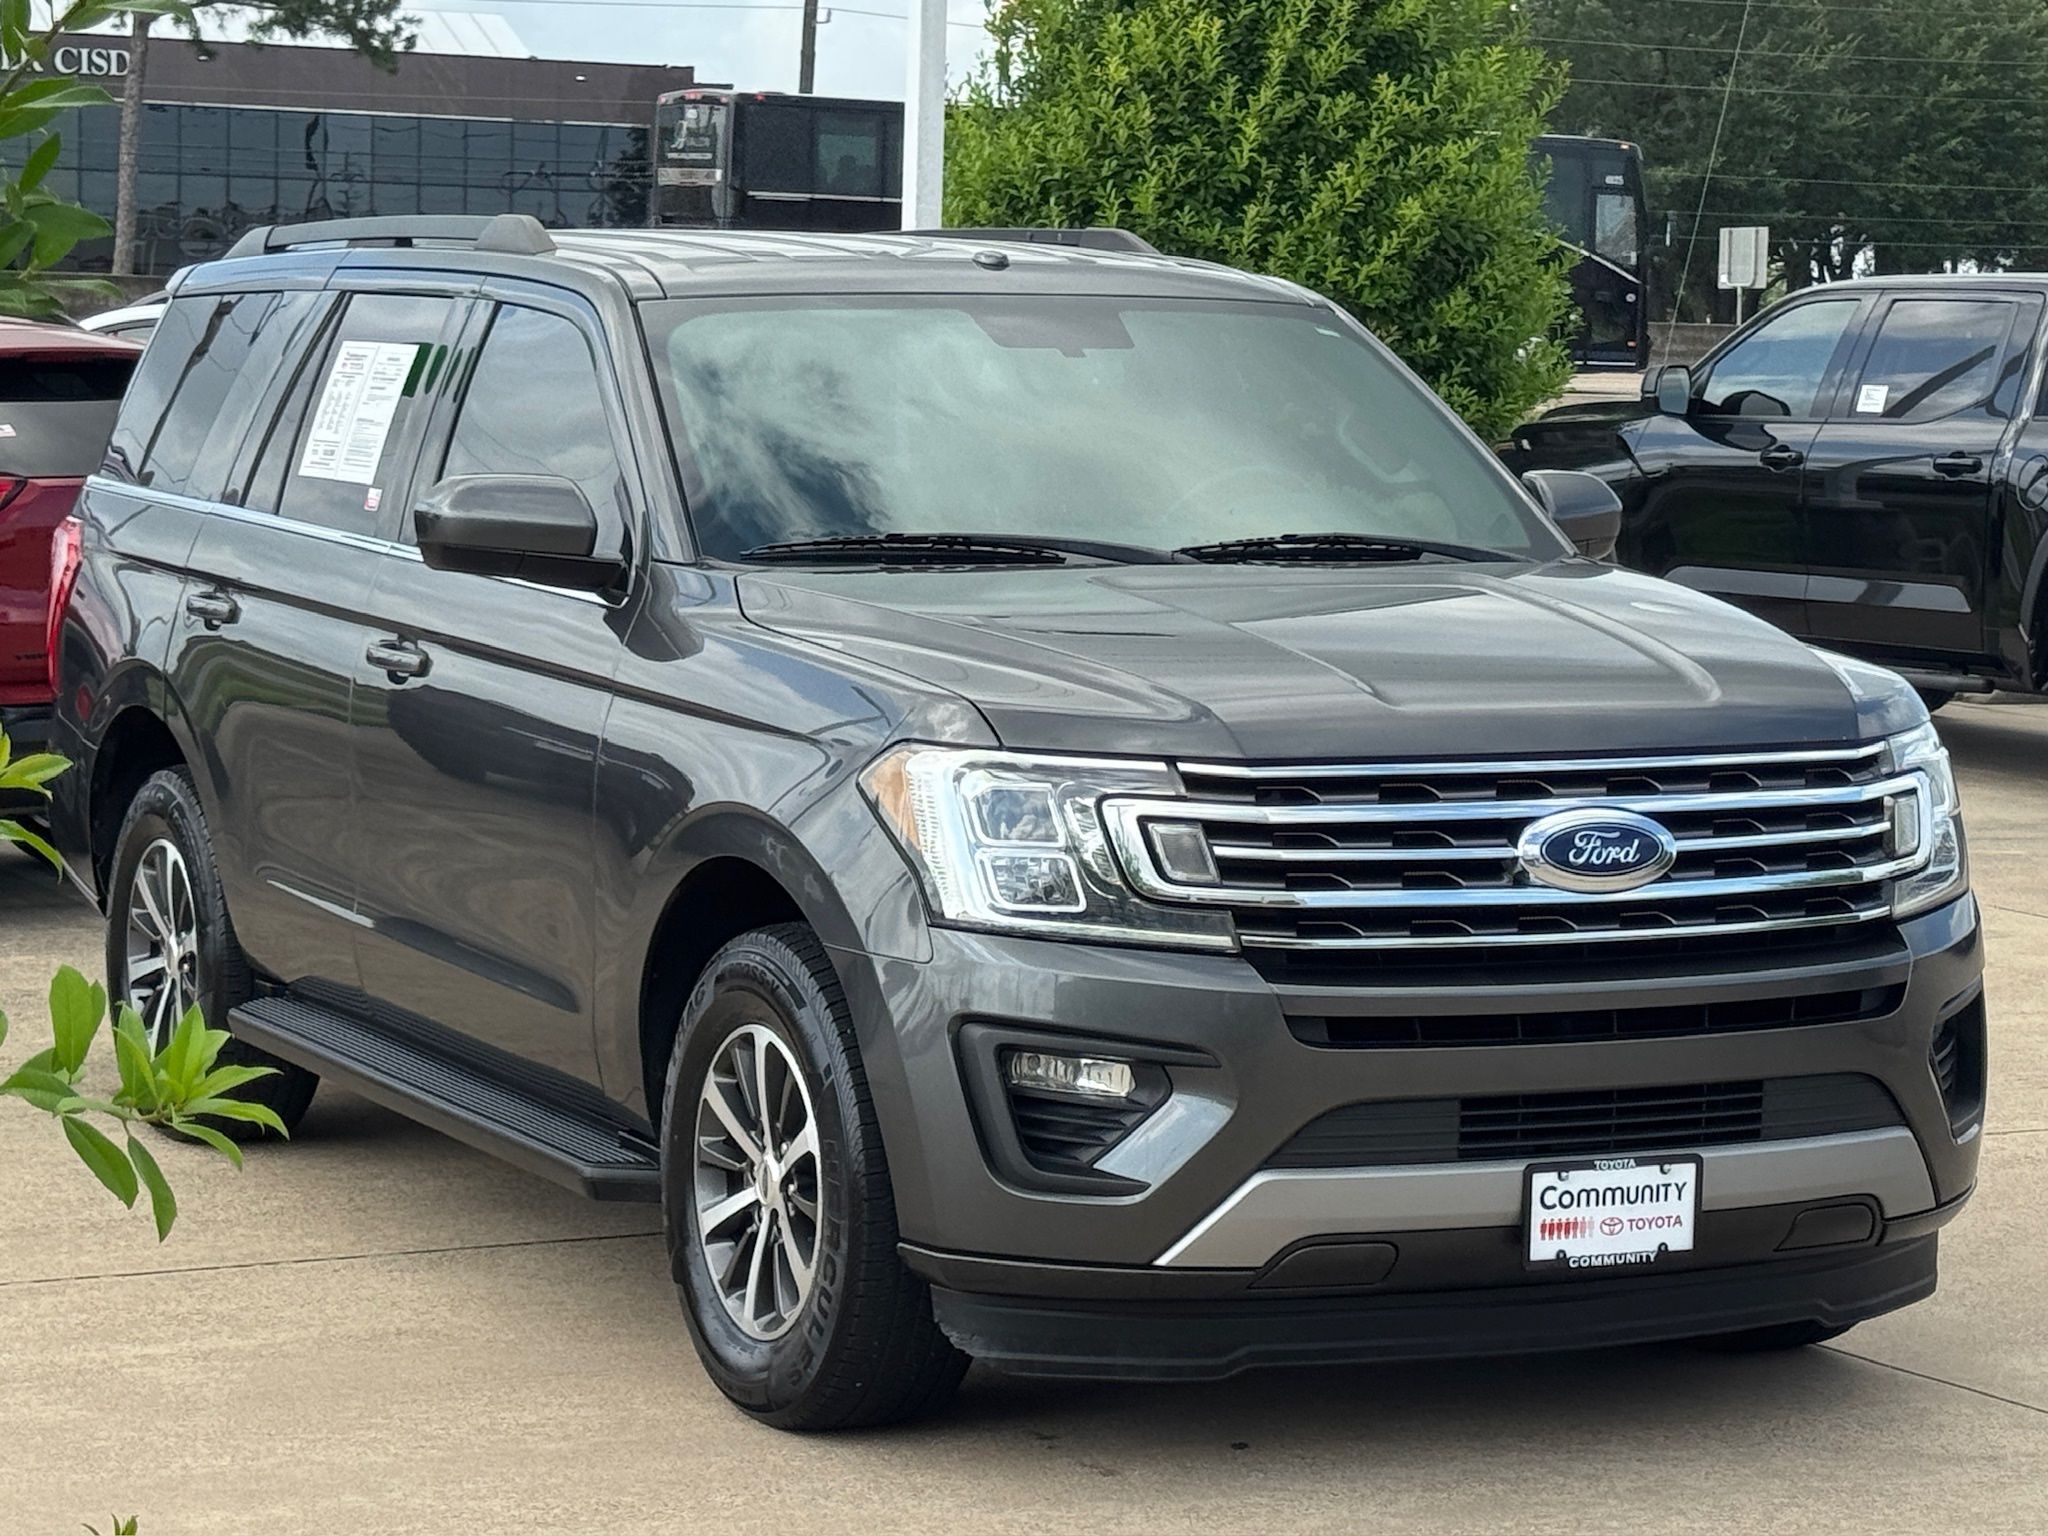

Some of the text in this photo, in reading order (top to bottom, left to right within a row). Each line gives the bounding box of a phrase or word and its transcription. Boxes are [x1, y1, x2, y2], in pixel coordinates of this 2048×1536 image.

[54, 46, 131, 76] CISD
[1568, 831, 1640, 866] Ford
[1594, 1158, 1636, 1171] TOYOTA
[1627, 1215, 1683, 1232] TOYOTA
[1568, 1251, 1658, 1268] COMMUNITY
